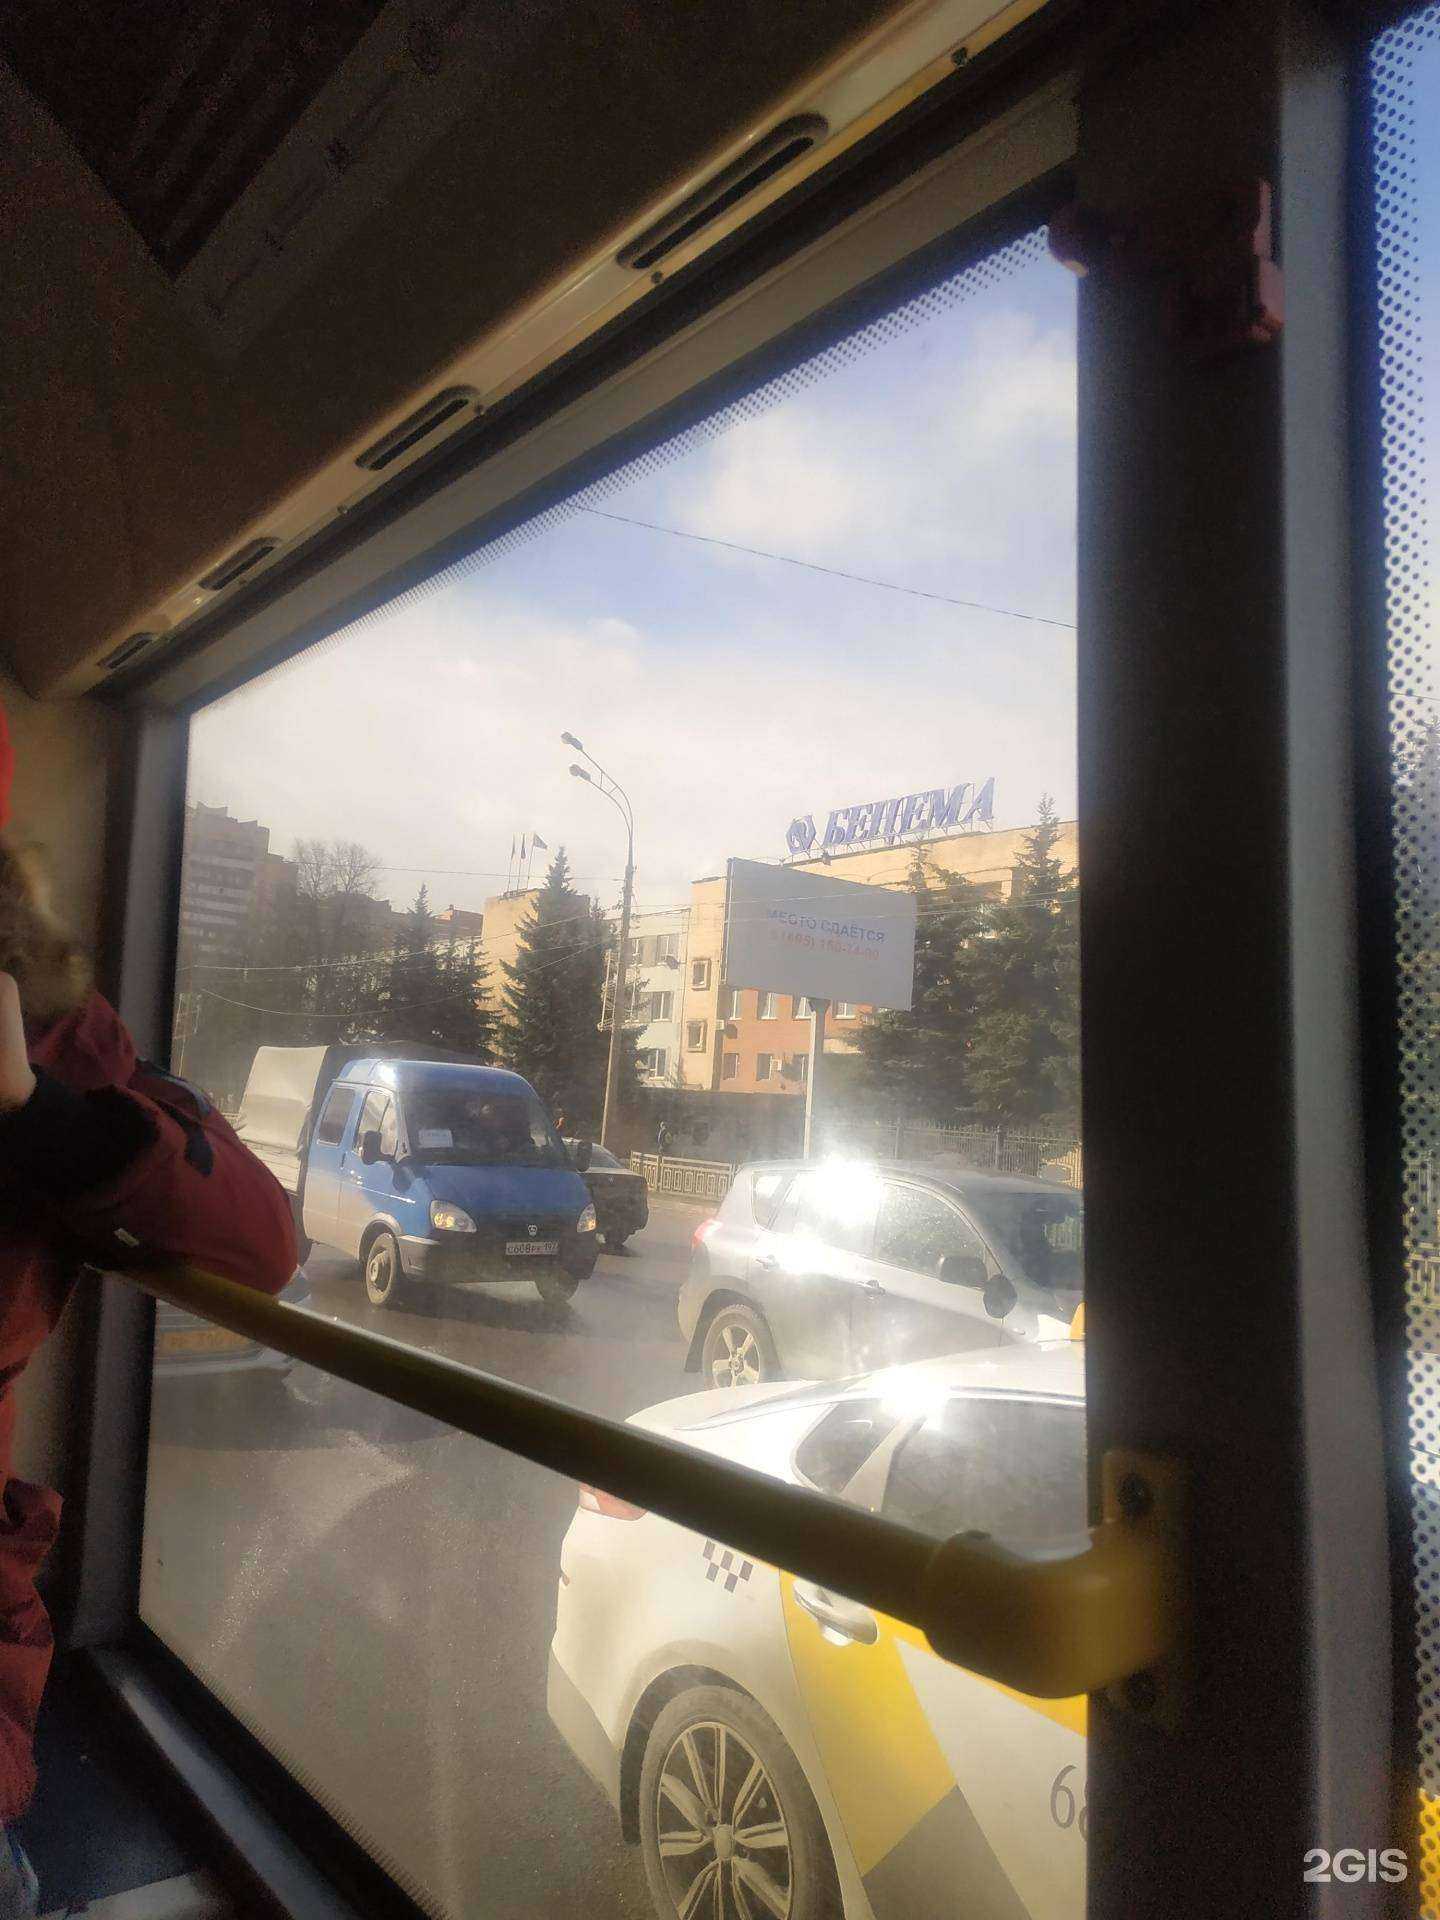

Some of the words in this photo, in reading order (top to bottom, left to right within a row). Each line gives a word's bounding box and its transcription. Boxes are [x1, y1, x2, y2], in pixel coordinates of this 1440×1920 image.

[823, 777, 995, 845] БЕЦЕМА
[767, 909, 817, 929] МЕСТО
[821, 919, 886, 942] СДАЁТСЯ
